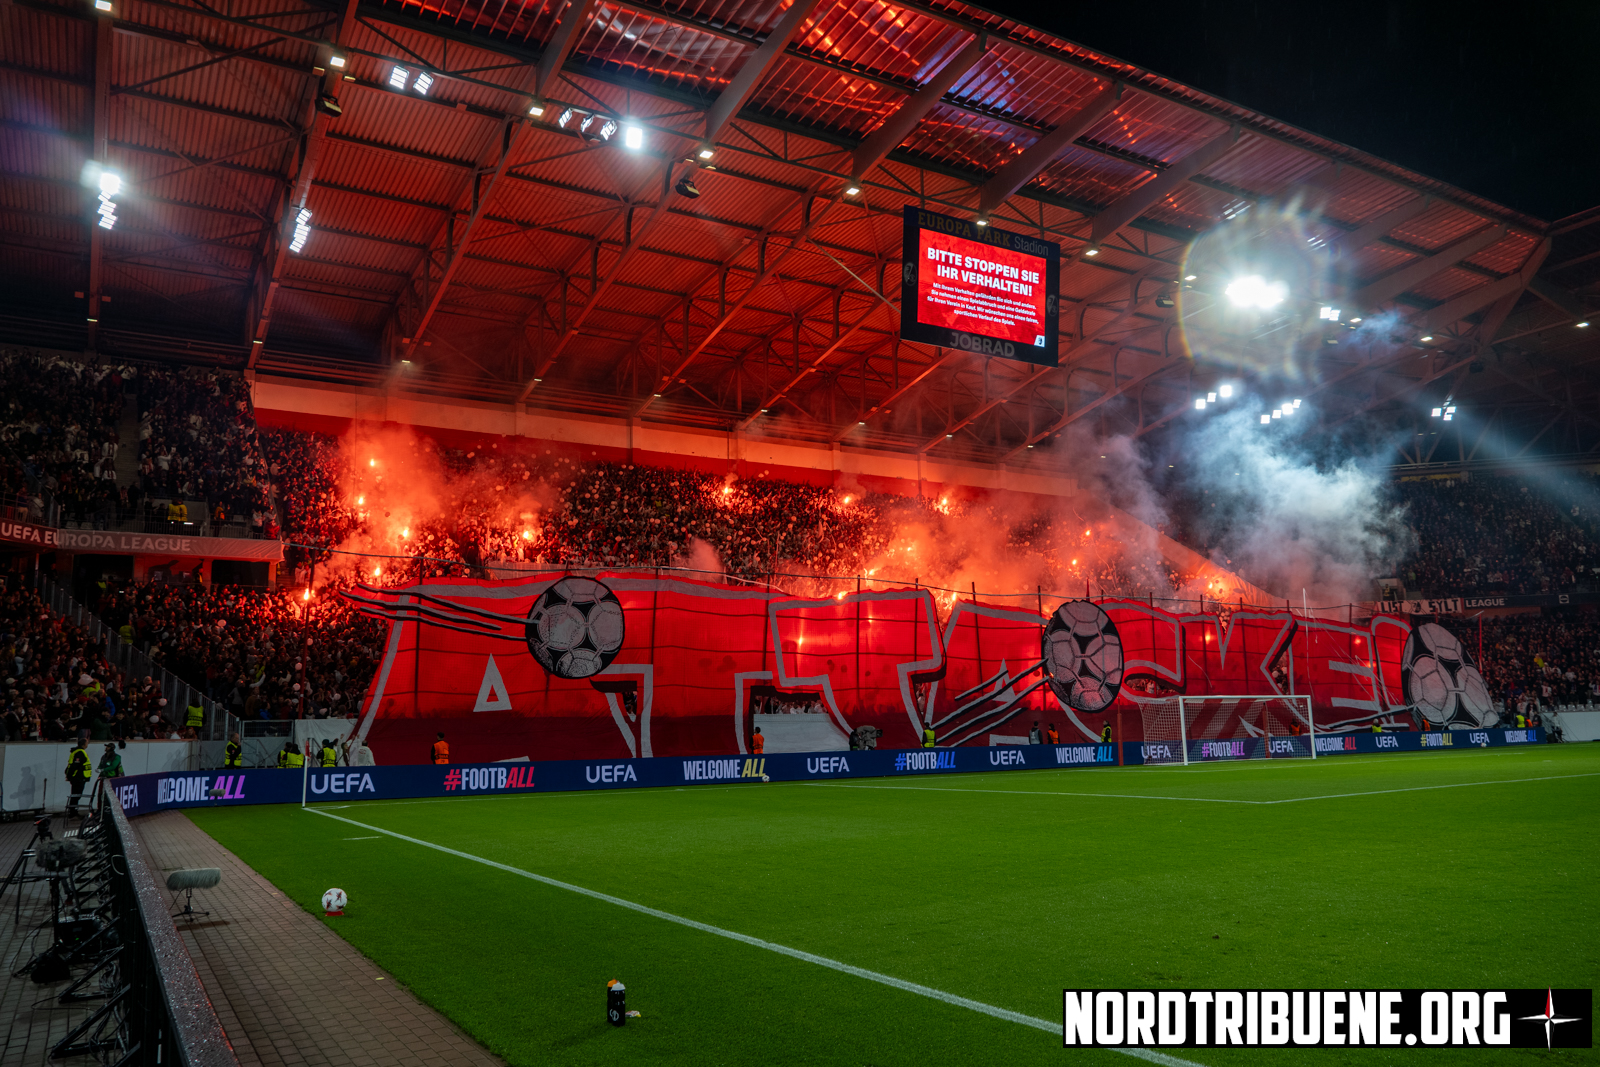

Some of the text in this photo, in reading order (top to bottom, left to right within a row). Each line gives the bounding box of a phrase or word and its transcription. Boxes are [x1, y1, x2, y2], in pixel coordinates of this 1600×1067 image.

[918, 211, 1049, 256] EUROPA PARK Stadion
[928, 248, 1040, 284] BITTE STOPPEN SIE
[937, 265, 958, 280] IHR
[961, 270, 1032, 296] VERHALTEN!
[954, 288, 974, 297] Verhalten
[975, 292, 996, 301] gefährden
[946, 300, 960, 308] Verein
[984, 308, 1005, 318] wünschen
[970, 297, 996, 308] Spielabbruch
[1014, 308, 1036, 316] Geldstrafe
[954, 309, 978, 319] sportlichen
[978, 313, 994, 322] Verlauf
[1002, 318, 1016, 326] Spiels.
[950, 332, 1015, 358] JOBRAD
[1, 523, 191, 552] UEFA EUROPA LEAGUE
[1381, 601, 1404, 613] LIST
[1428, 599, 1459, 613] SYLT
[1466, 598, 1505, 608] LEAGUE
[1315, 736, 1357, 751] WELCOME ALL
[1376, 736, 1399, 748] UEFA
[1420, 733, 1453, 747] #FOOTBALL
[1469, 732, 1490, 744] UEFA
[1505, 730, 1538, 742] WELCOME ALL
[1056, 746, 1114, 764] WELCOME ALL
[1141, 746, 1172, 759] UEFA
[1202, 742, 1245, 758] #FOOTBALL
[1268, 740, 1294, 753] UEFA
[807, 756, 850, 774] UEFA
[895, 751, 956, 771] #FOOTBALL
[990, 750, 1025, 766] UEFA
[444, 766, 535, 790] #FOOTBALL
[586, 764, 637, 784] UEFA
[683, 758, 766, 780] WELCOME ALL
[158, 775, 246, 804] WELCOME ALL
[311, 773, 375, 794] UEFA
[116, 784, 138, 810] UEFA
